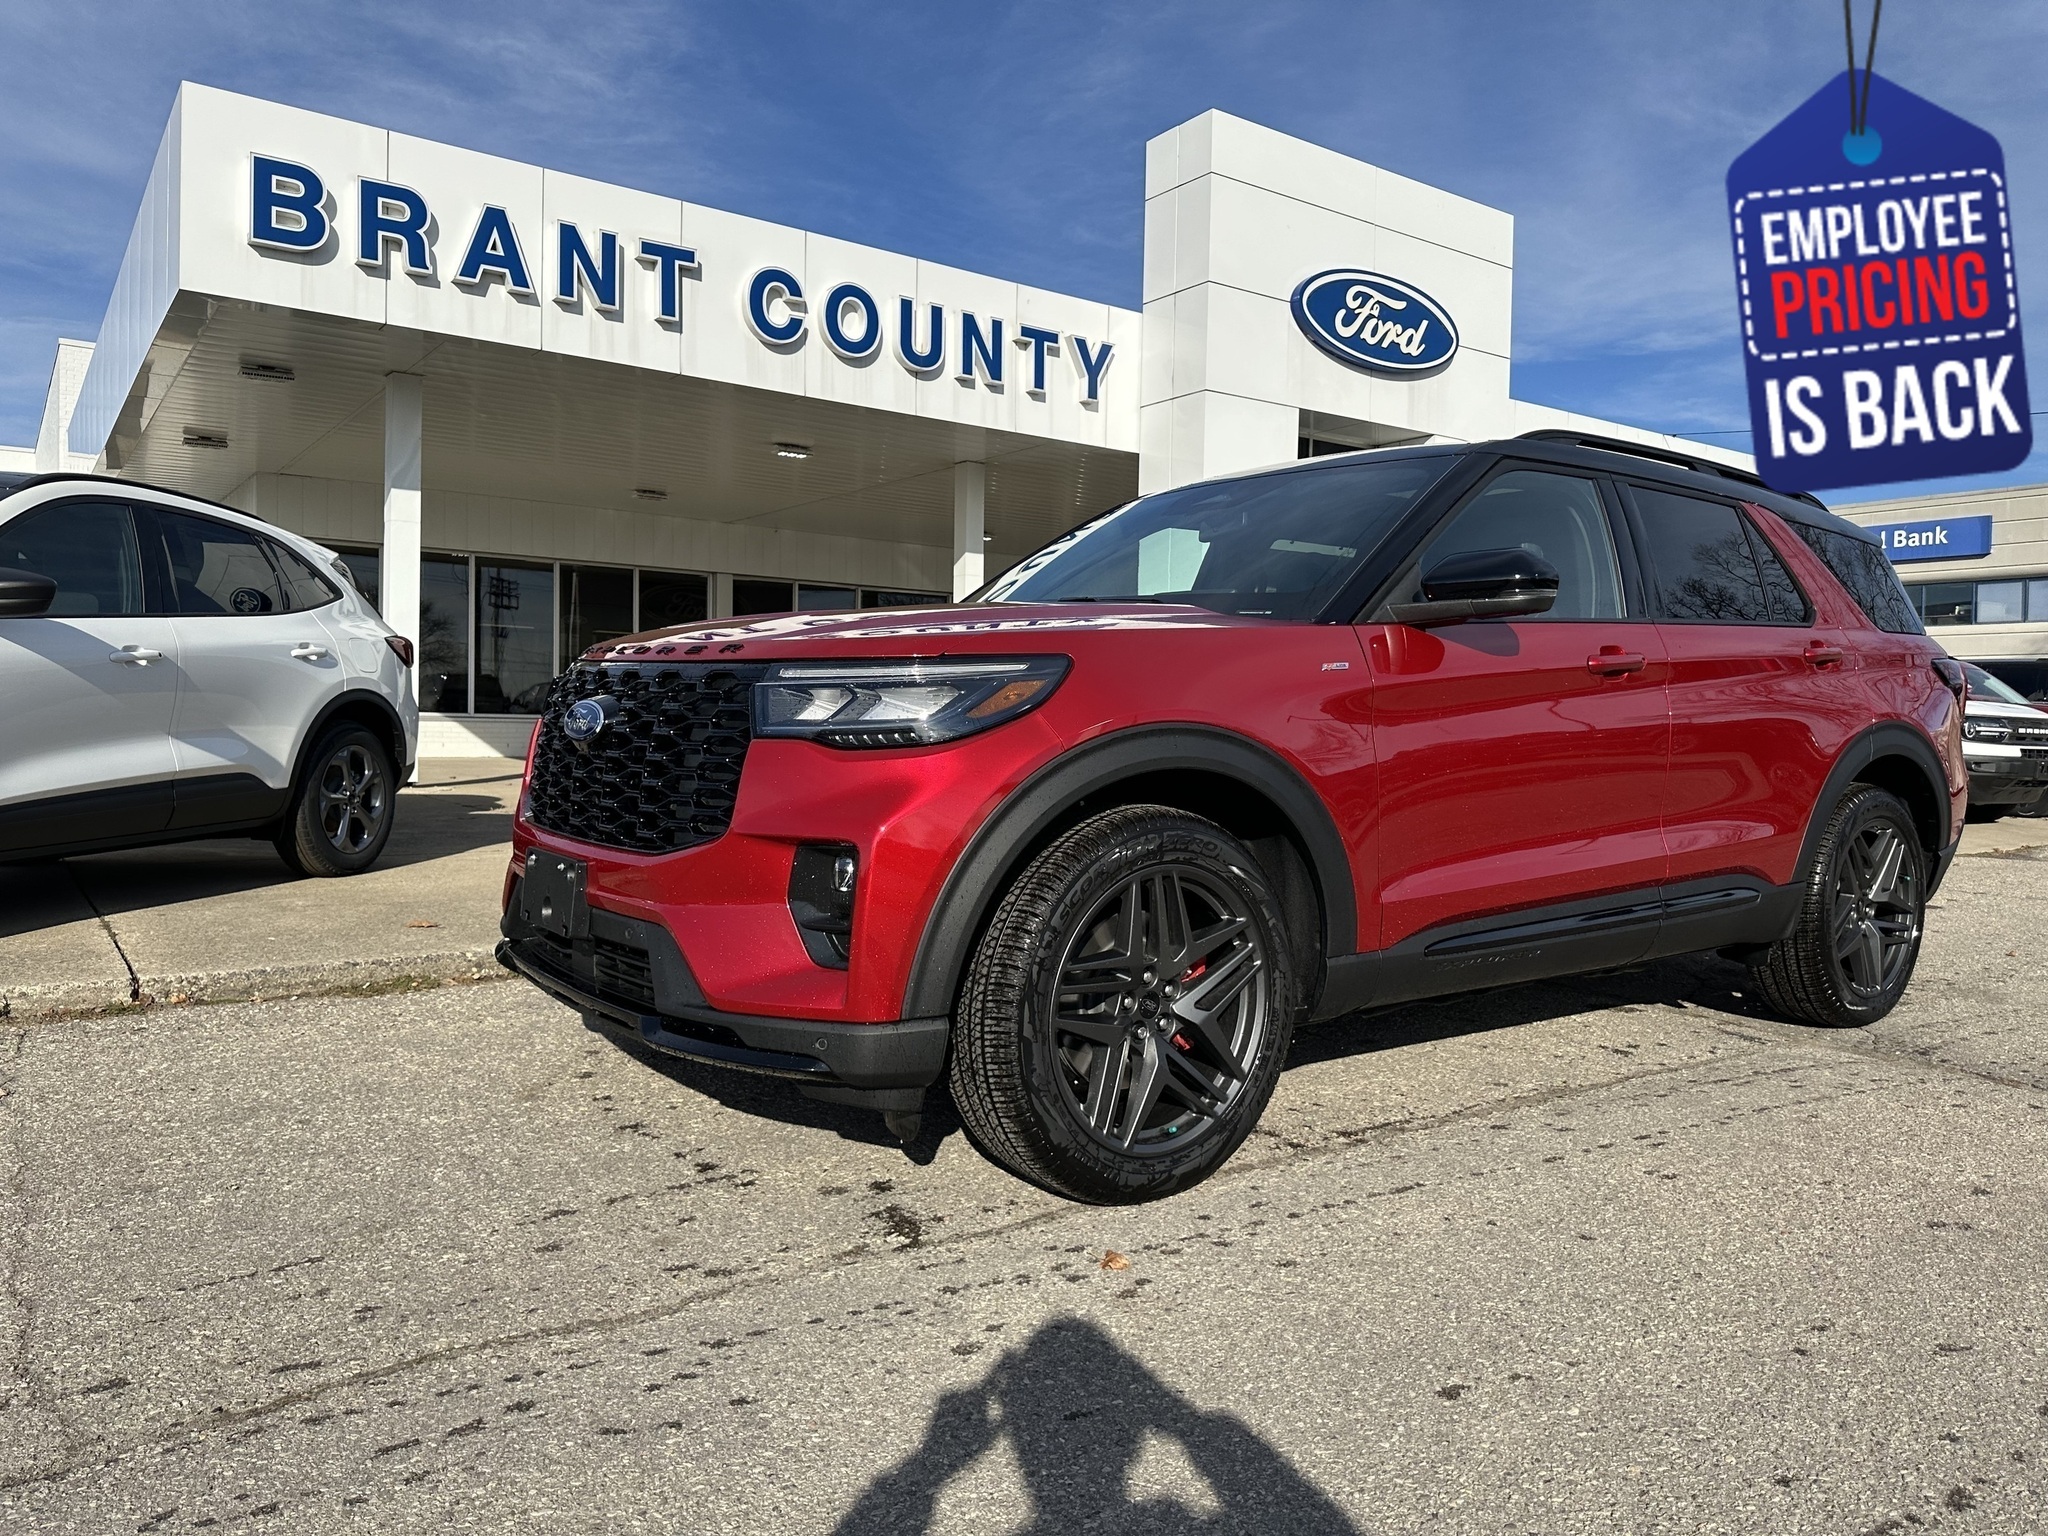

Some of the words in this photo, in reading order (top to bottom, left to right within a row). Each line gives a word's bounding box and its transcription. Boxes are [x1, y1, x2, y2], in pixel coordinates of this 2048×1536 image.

[248, 152, 699, 322] BRANT
[745, 266, 1114, 403] COUNTY
[1335, 285, 1428, 356] Ford
[1893, 526, 1948, 548] Bank
[568, 707, 593, 732] Ford
